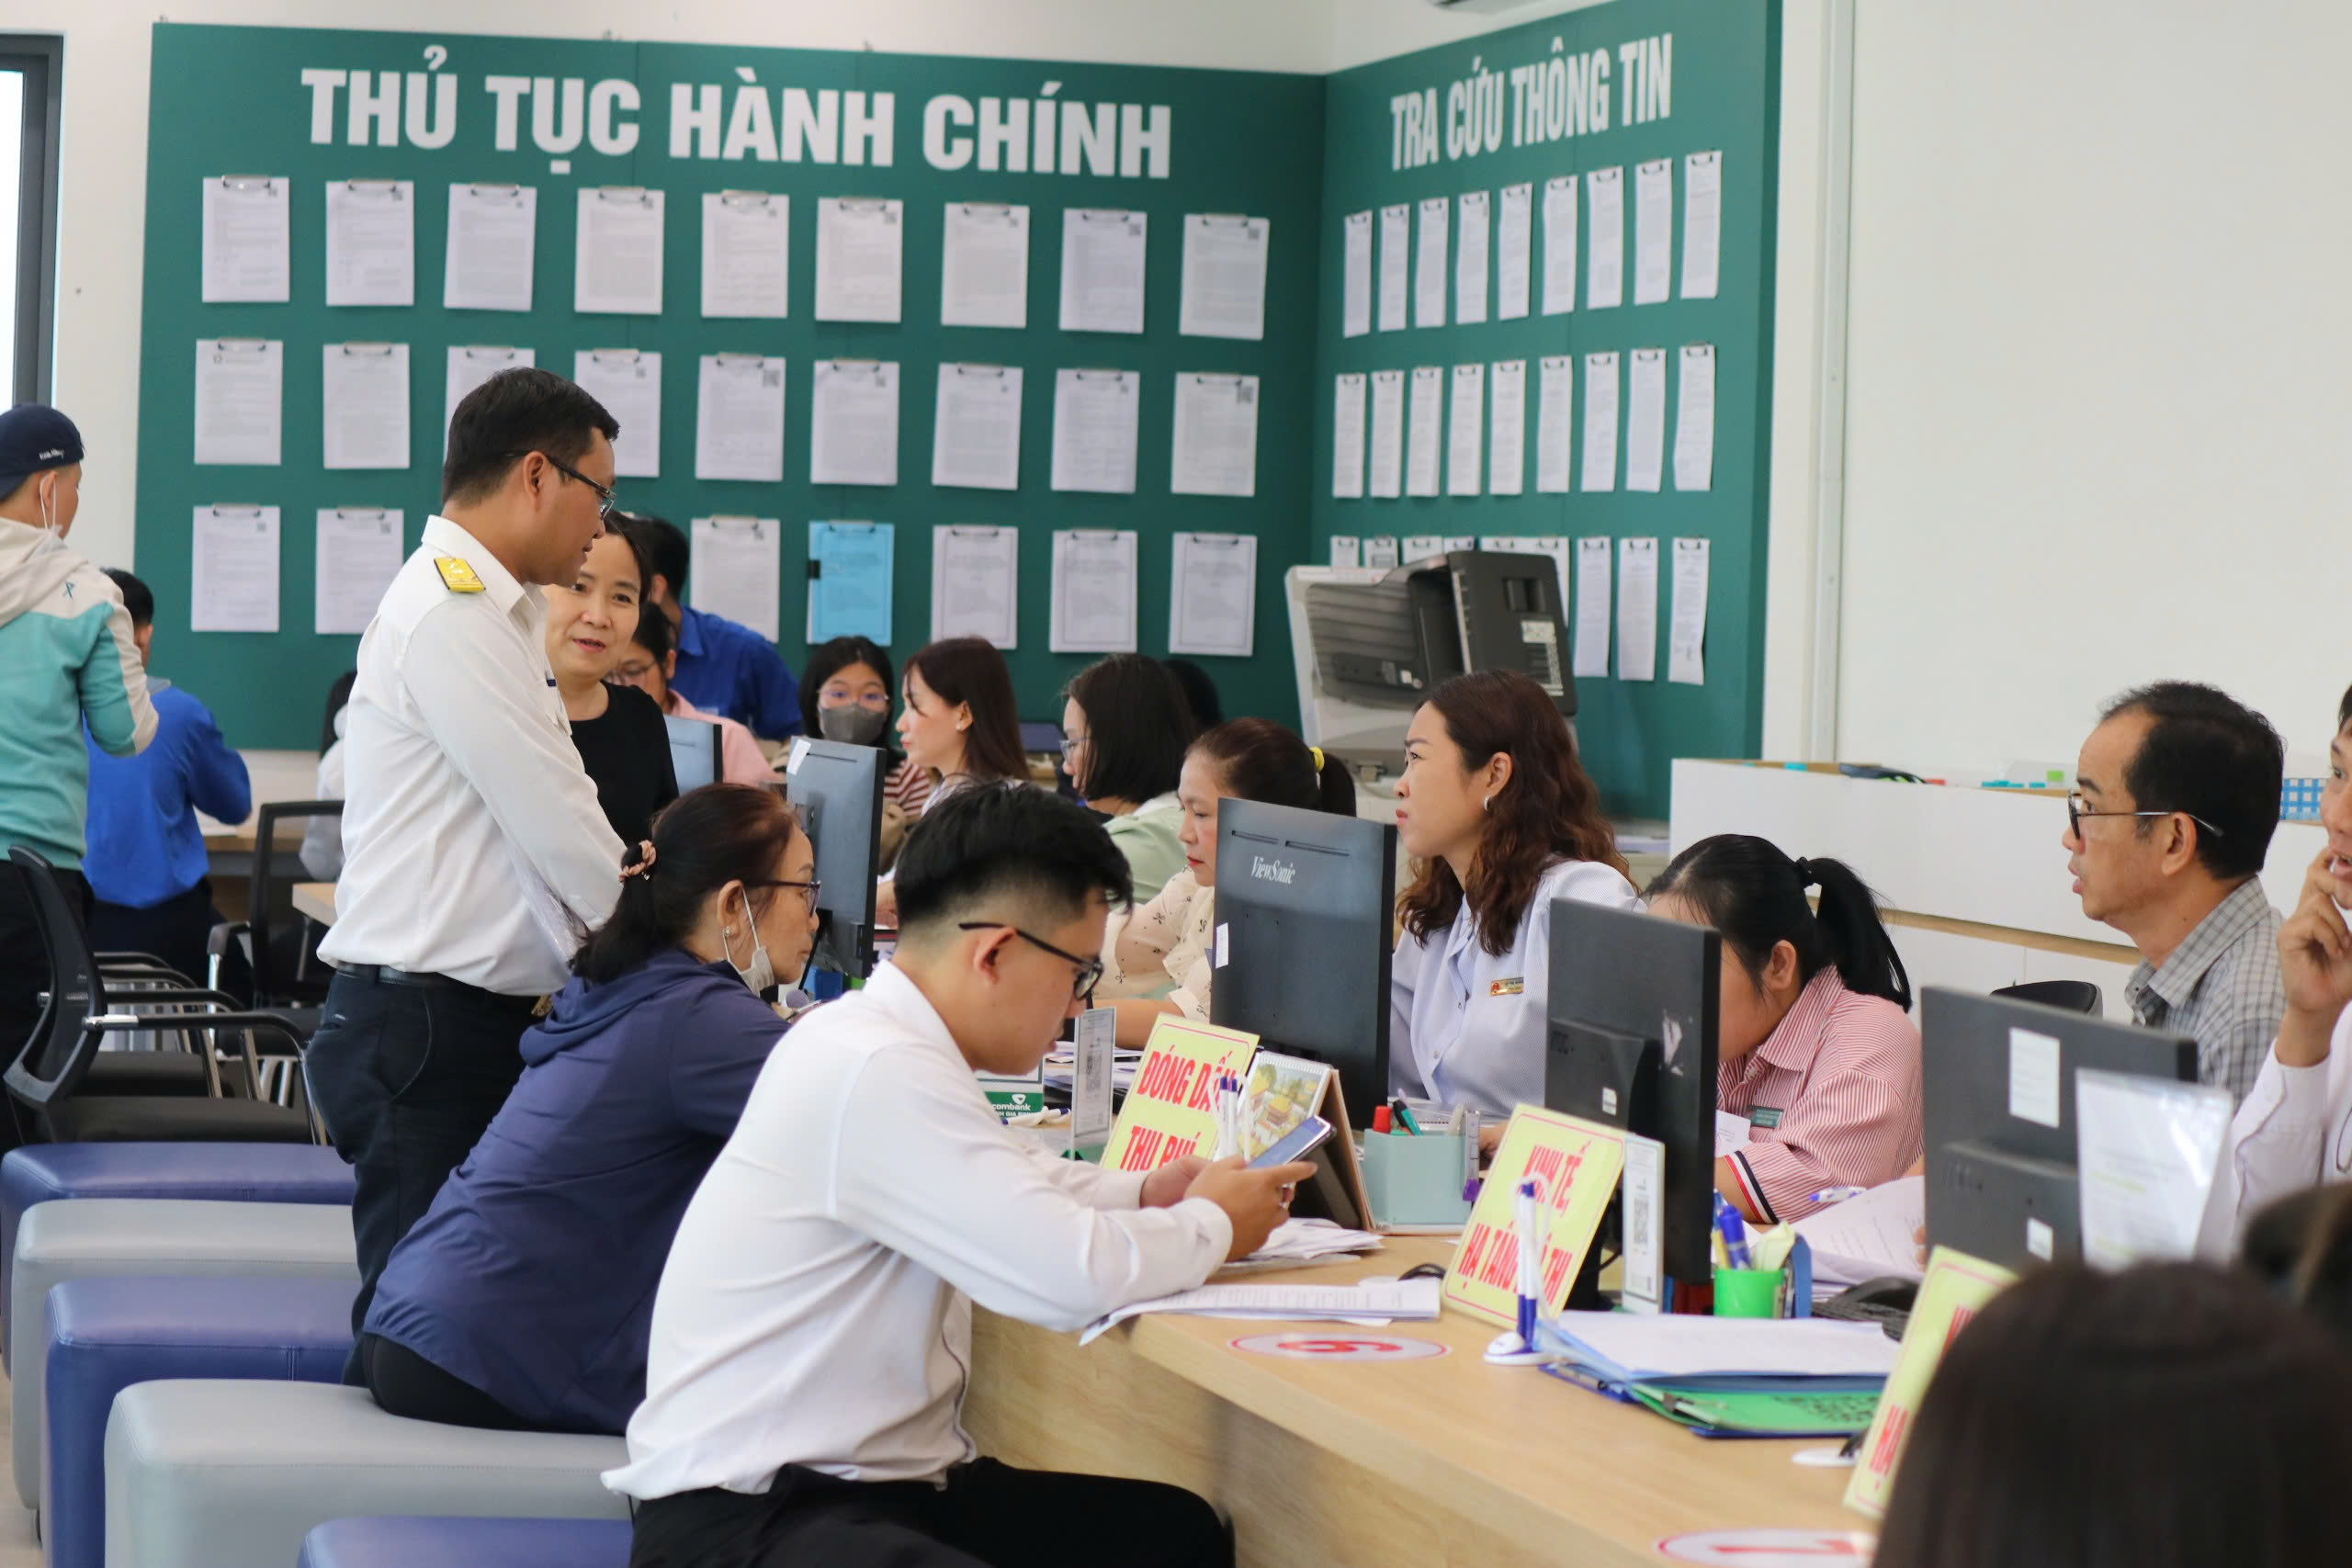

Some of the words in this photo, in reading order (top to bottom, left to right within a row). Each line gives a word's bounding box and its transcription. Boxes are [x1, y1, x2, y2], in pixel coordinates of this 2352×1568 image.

[301, 45, 458, 149] THỦ
[485, 75, 641, 175] TỤC
[669, 67, 896, 167] HÀNH
[922, 81, 1171, 179] CHÍNH
[1390, 88, 1440, 171] TRA
[1446, 55, 1505, 160] CỨU
[1510, 37, 1610, 148] THÔNG
[1619, 33, 1672, 127] TIN
[1251, 856, 1295, 884] ViewSonic
[1136, 1045, 1196, 1105] ĐÓNG
[1187, 1051, 1238, 1111] DẤ
[1119, 1125, 1165, 1172] THU
